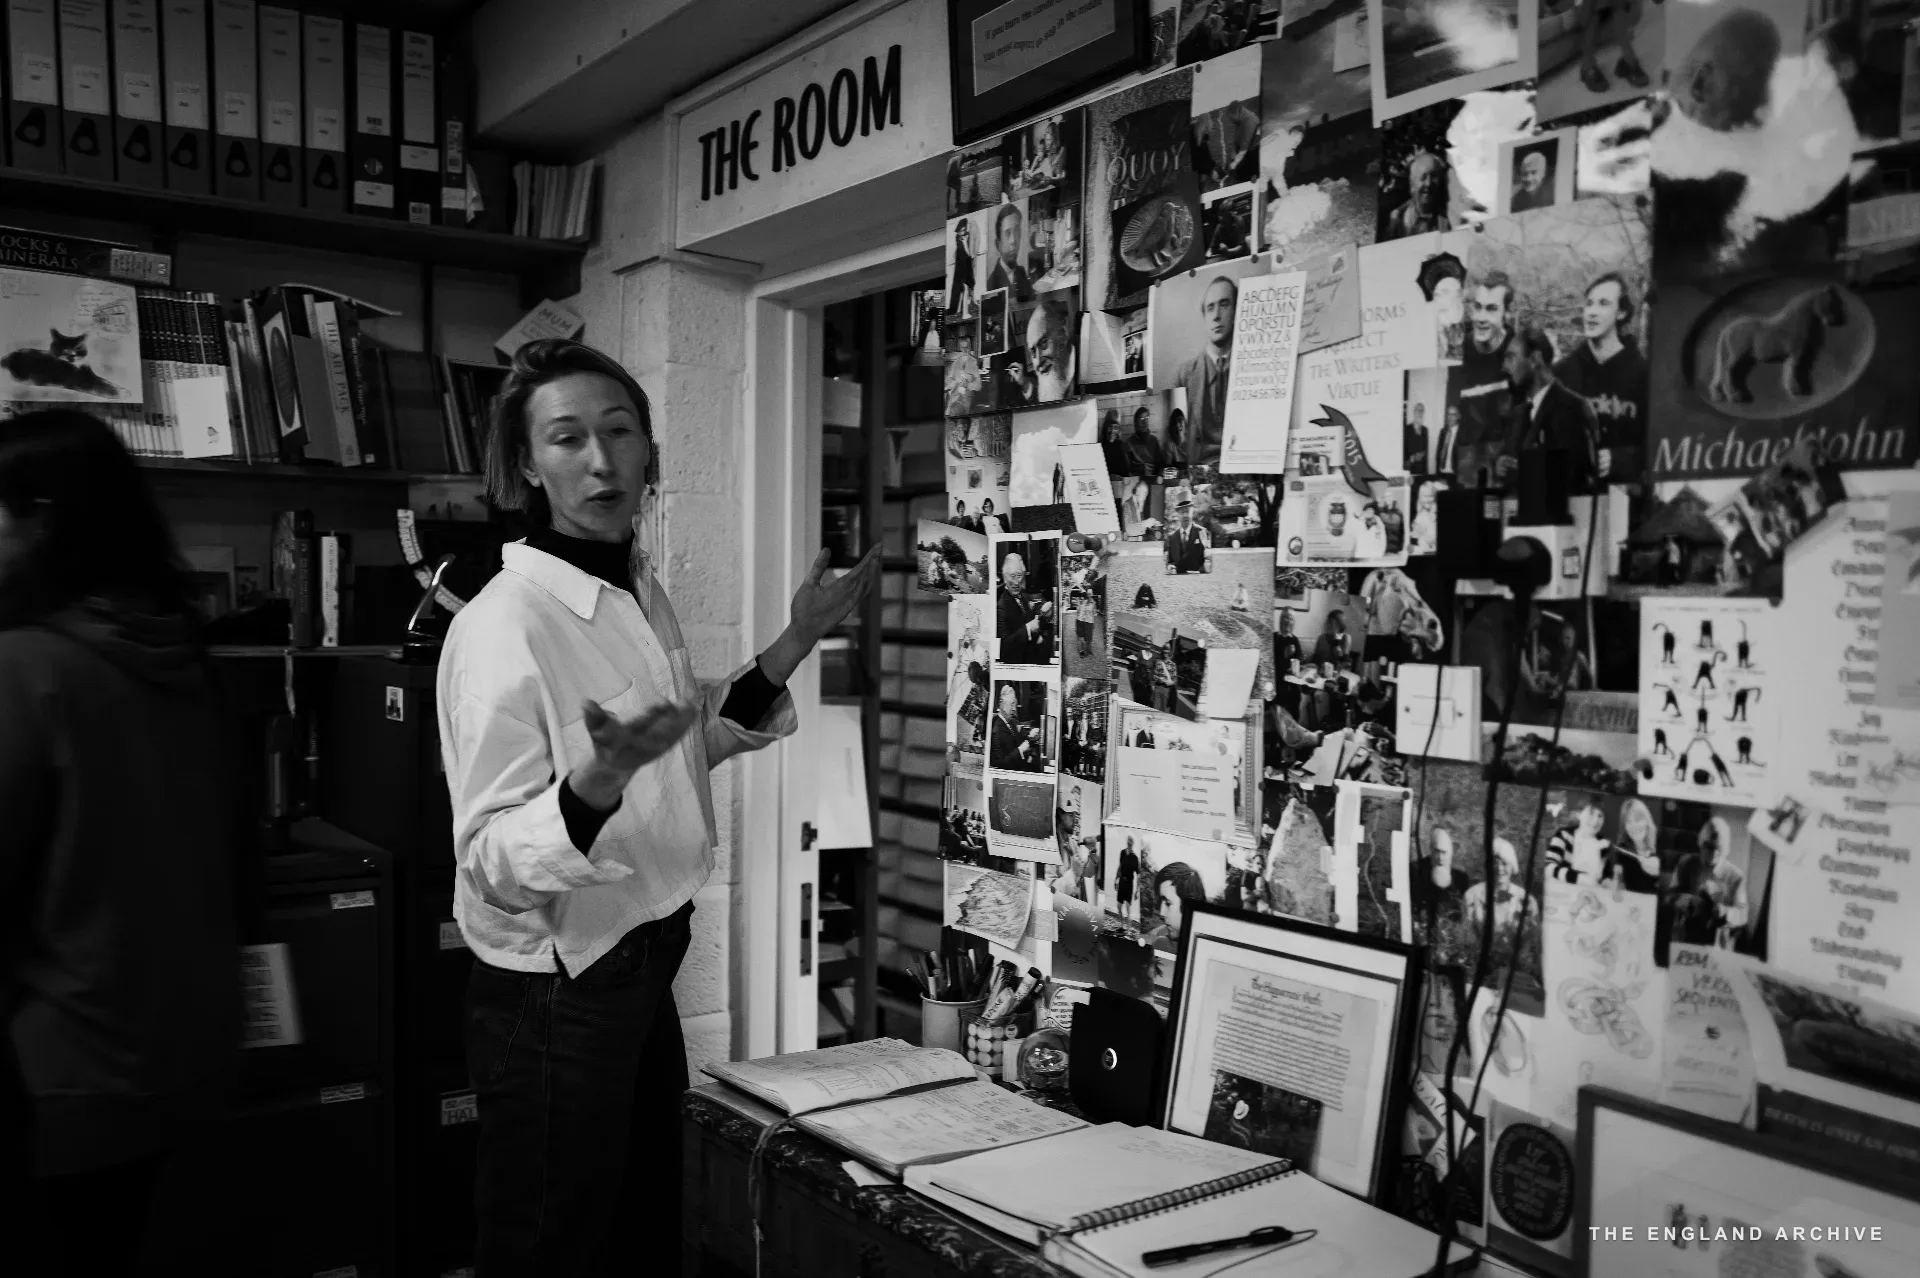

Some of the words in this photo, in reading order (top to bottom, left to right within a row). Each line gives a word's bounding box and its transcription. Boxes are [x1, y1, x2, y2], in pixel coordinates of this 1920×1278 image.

[698, 109, 762, 201] THE
[772, 44, 902, 173] ROOM
[0, 234, 51, 253] OCKS
